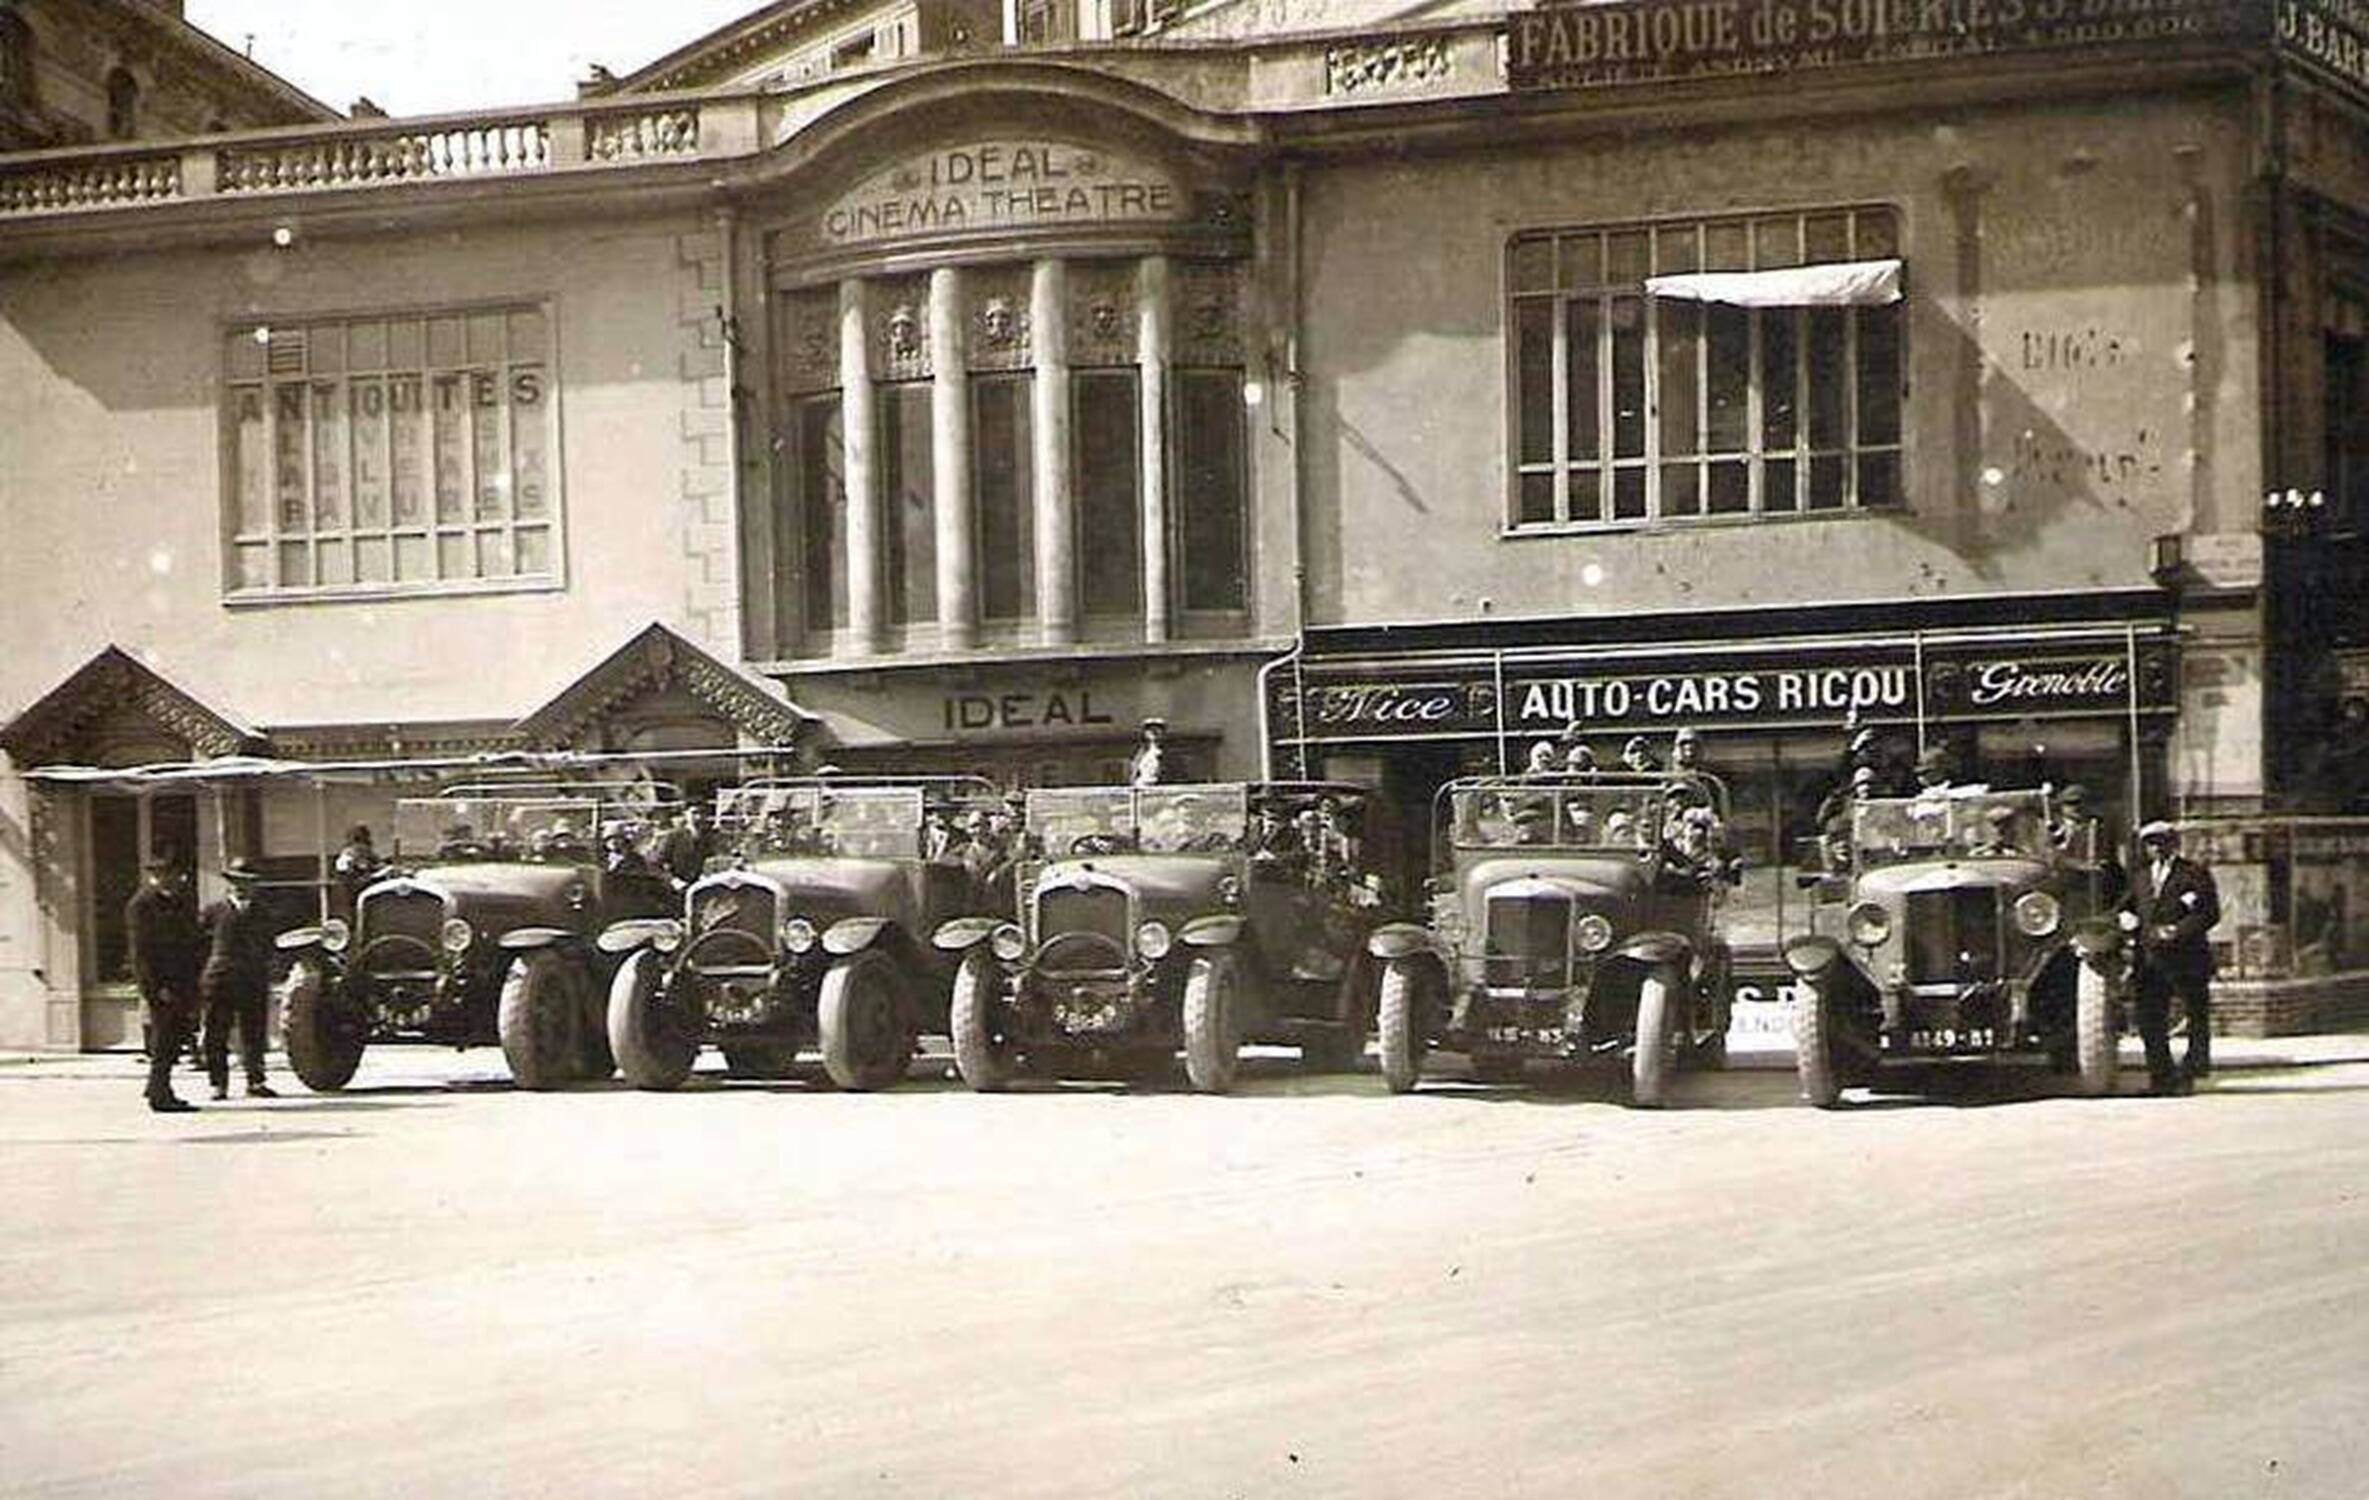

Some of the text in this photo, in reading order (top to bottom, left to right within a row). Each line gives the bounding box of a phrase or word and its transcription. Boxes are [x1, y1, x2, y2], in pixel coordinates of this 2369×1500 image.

[1518, 2, 1740, 68] FABRIQUE
[1751, 0, 1797, 46] de
[931, 147, 1068, 187] IDEAL
[827, 184, 1174, 236] CINEMA THEATRE
[1318, 684, 1454, 723] Nice
[1519, 668, 1906, 720] AUTO-CARS RICOU
[1971, 659, 2128, 706] Grenoble
[943, 692, 1113, 730] IDEAL
